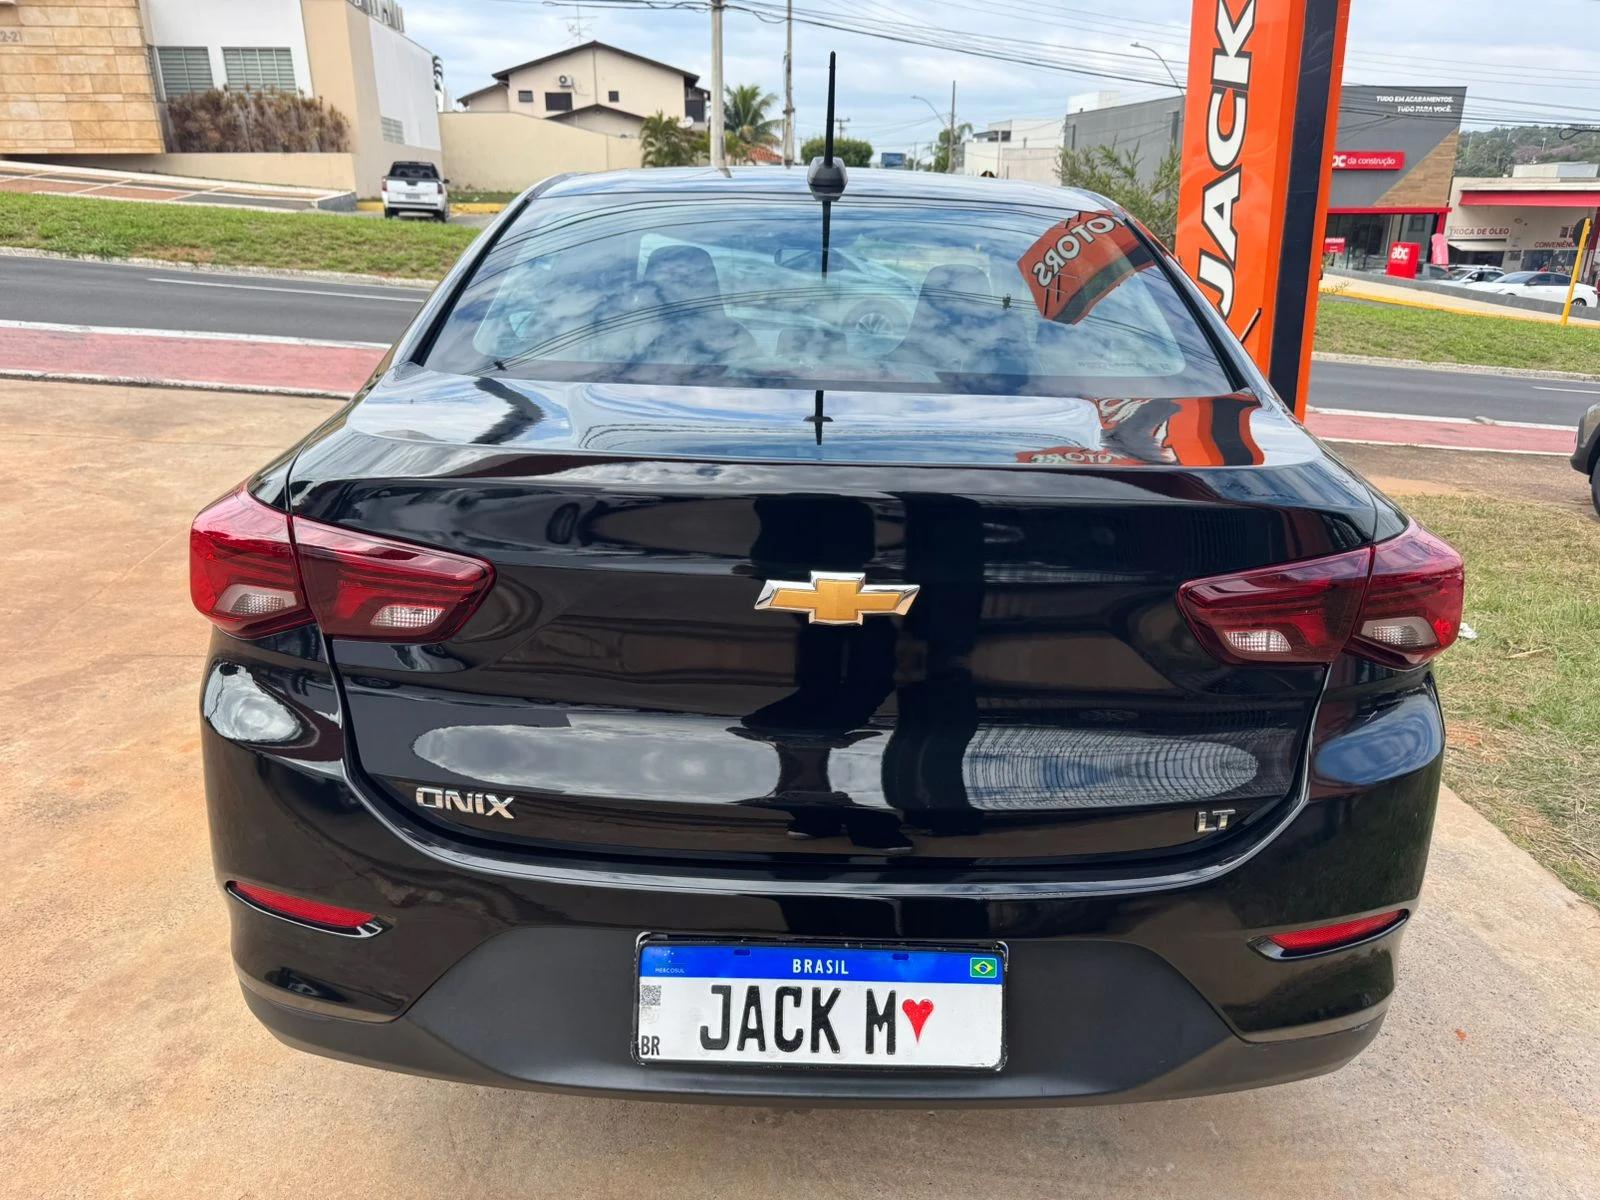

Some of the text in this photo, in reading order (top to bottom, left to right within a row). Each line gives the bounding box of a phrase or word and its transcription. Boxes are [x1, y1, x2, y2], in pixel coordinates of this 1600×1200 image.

[1376, 95, 1394, 103] TUDO
[1397, 105, 1415, 113] TUDO
[1197, 0, 1257, 322] JACK
[1347, 157, 1357, 165] da
[1357, 157, 1396, 166] construção
[1477, 227, 1488, 235] DE
[1488, 226, 1510, 235] ÓLEO
[1391, 245, 1409, 260] abc
[415, 786, 515, 820] ONIX
[1197, 809, 1236, 833] LT
[792, 958, 849, 975] BRASIL
[700, 984, 842, 1055] JACK
[641, 1035, 660, 1056] BR
